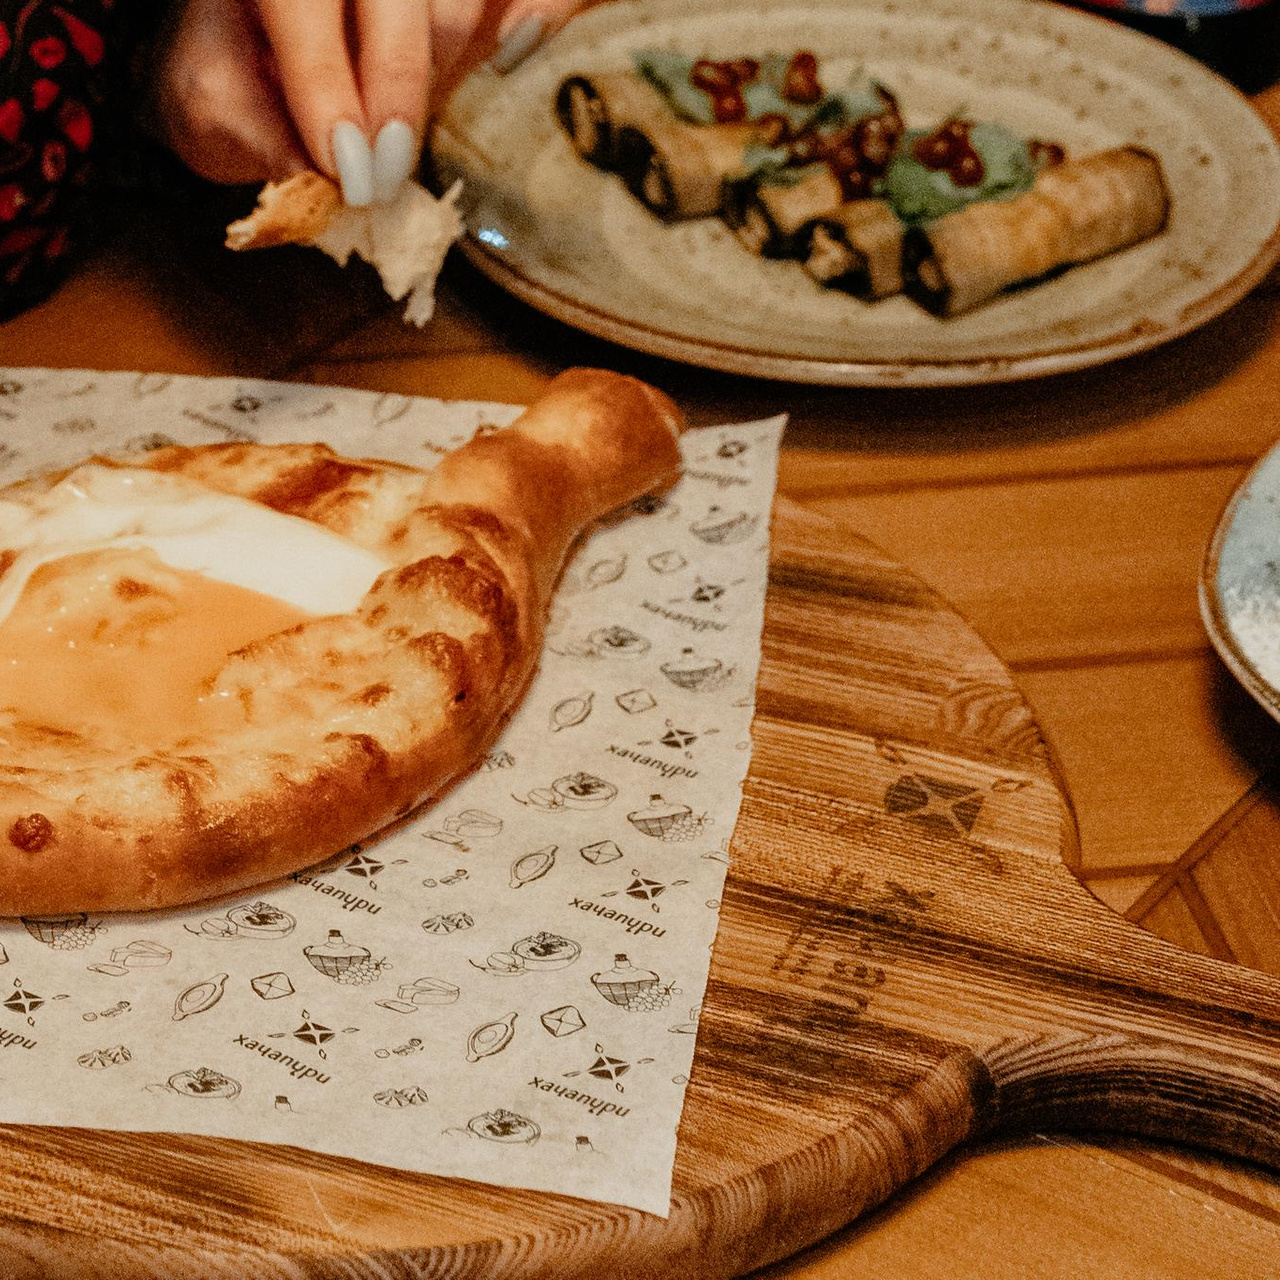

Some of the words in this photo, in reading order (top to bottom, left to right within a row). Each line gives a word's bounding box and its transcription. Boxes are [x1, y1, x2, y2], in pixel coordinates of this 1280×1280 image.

[567, 897, 667, 938] хачапури
[232, 1034, 331, 1084] хачапури
[527, 1076, 631, 1117] хачапури
